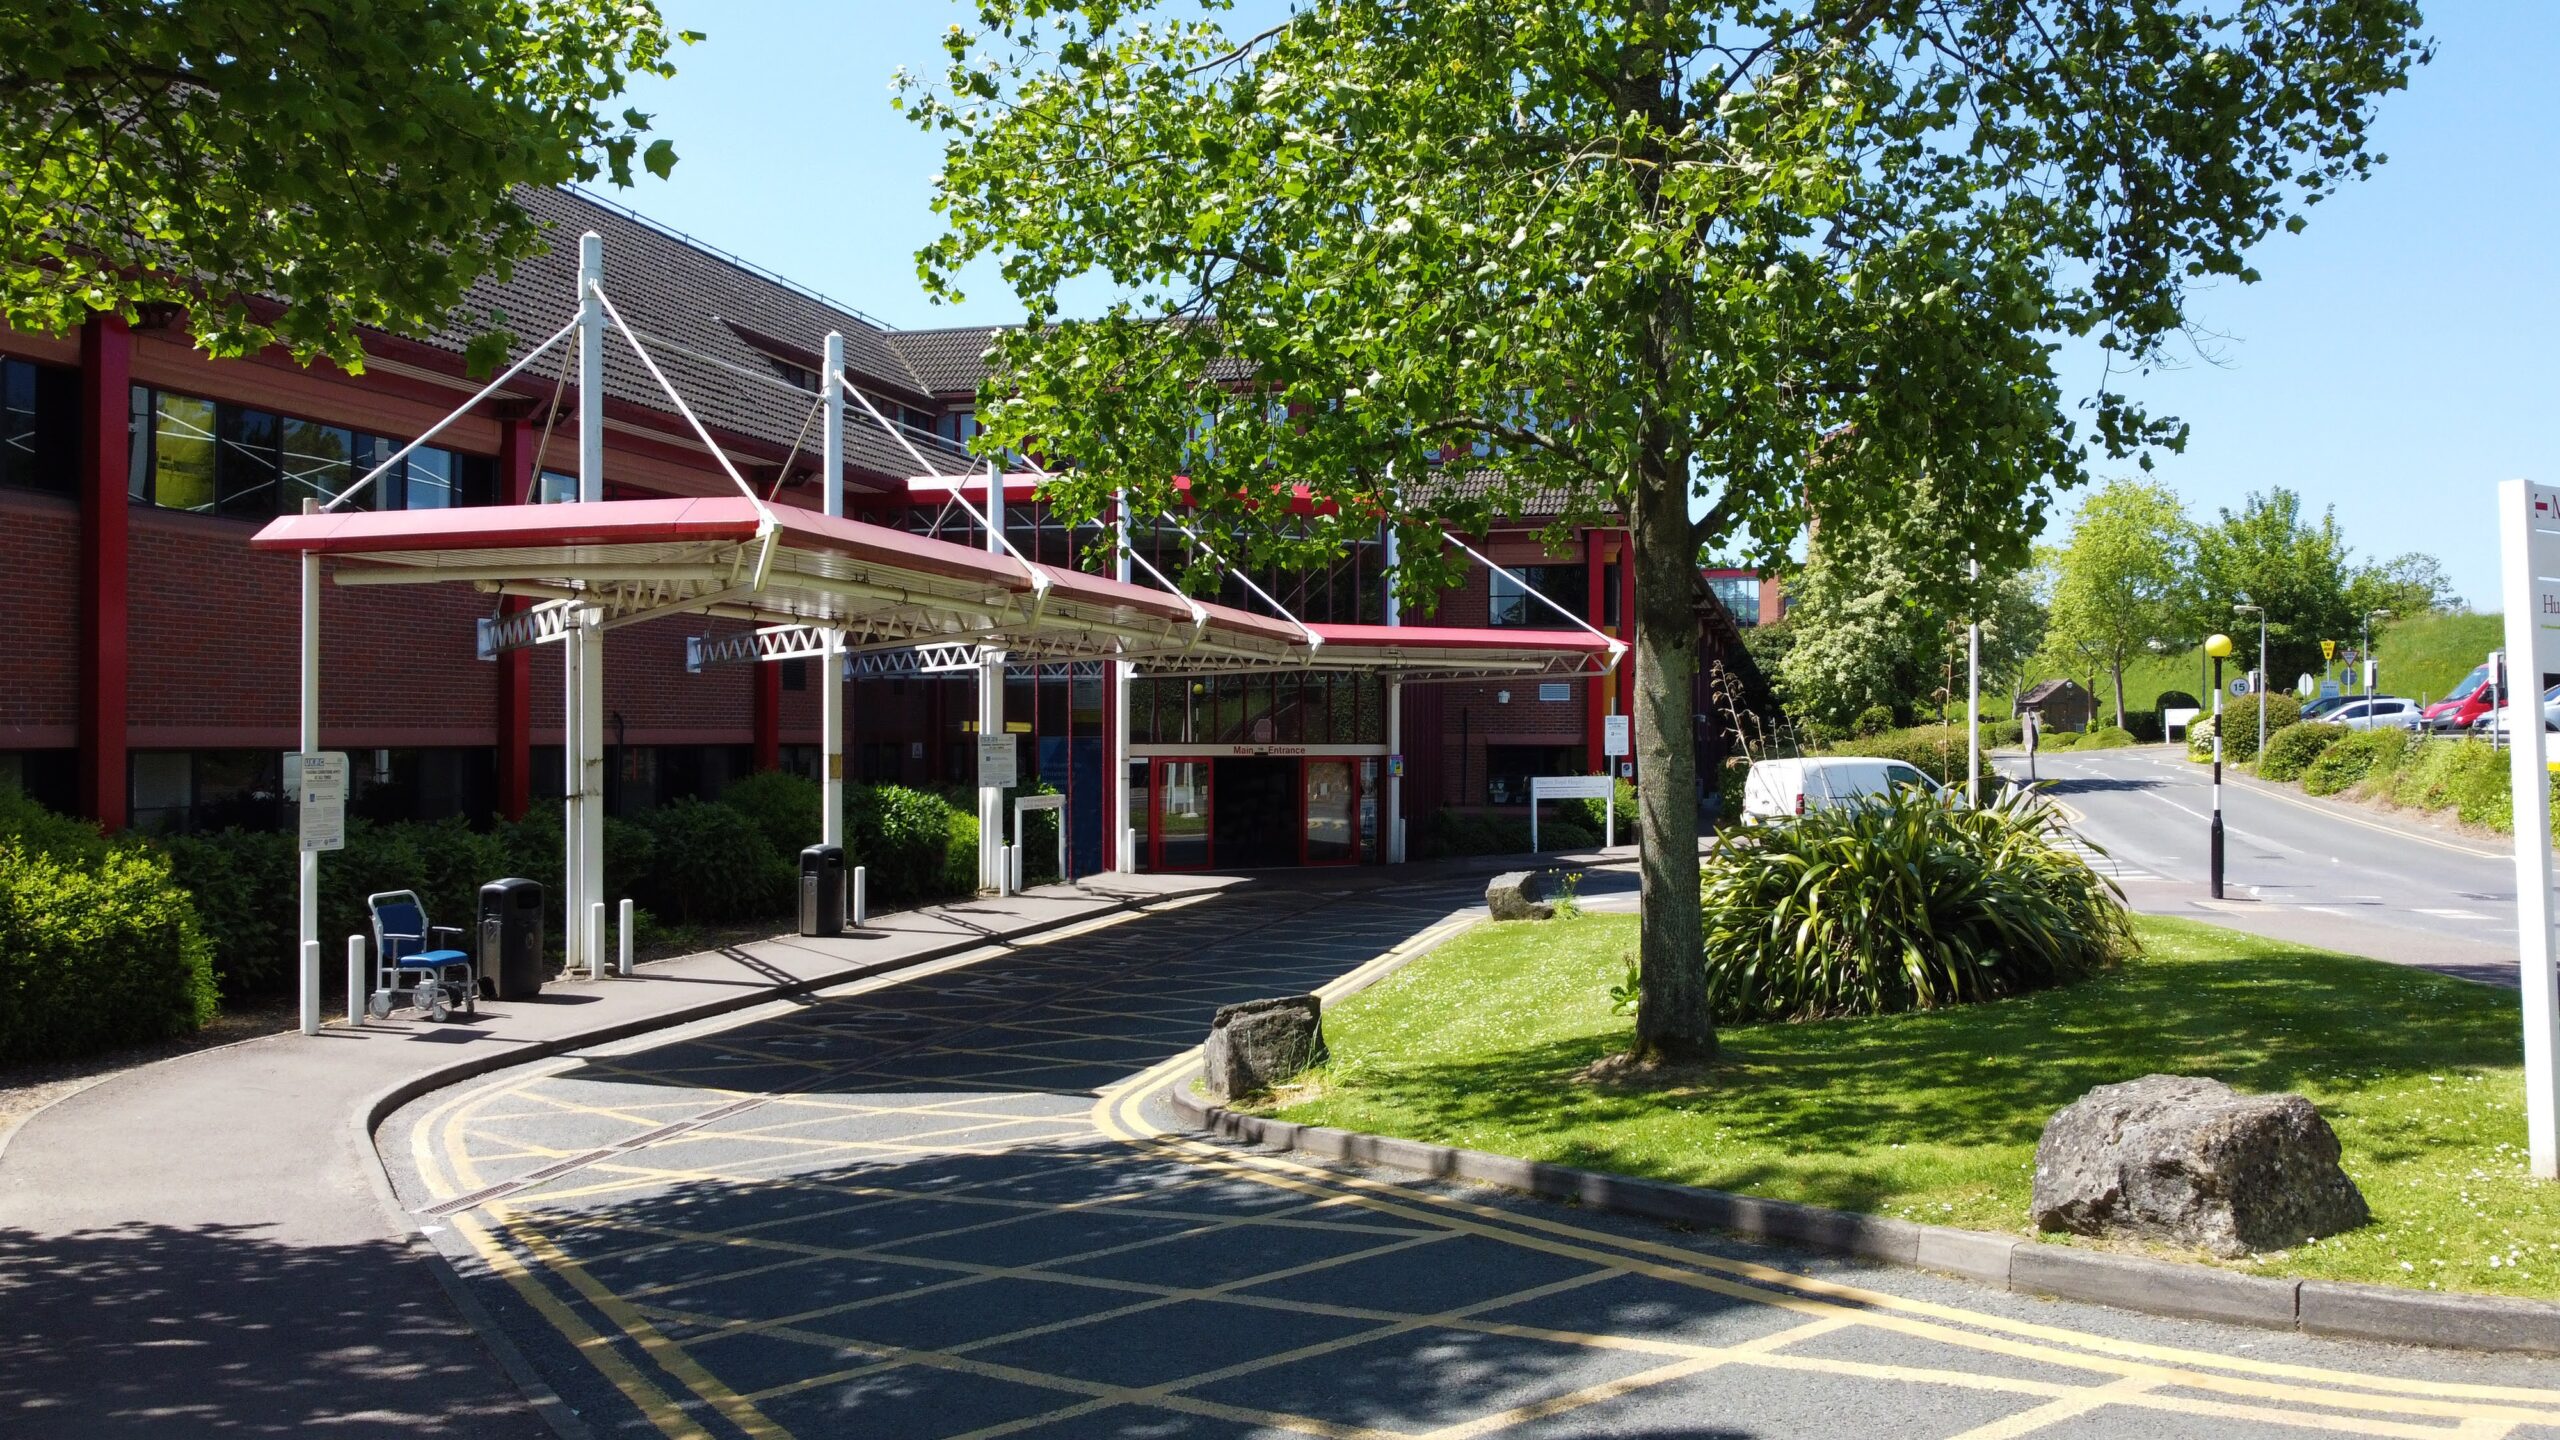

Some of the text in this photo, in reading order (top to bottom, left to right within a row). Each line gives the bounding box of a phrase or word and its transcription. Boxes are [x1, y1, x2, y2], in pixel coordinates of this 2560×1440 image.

[2234, 683, 2245, 691] 15
[1233, 746, 1306, 754] Main Entrance
